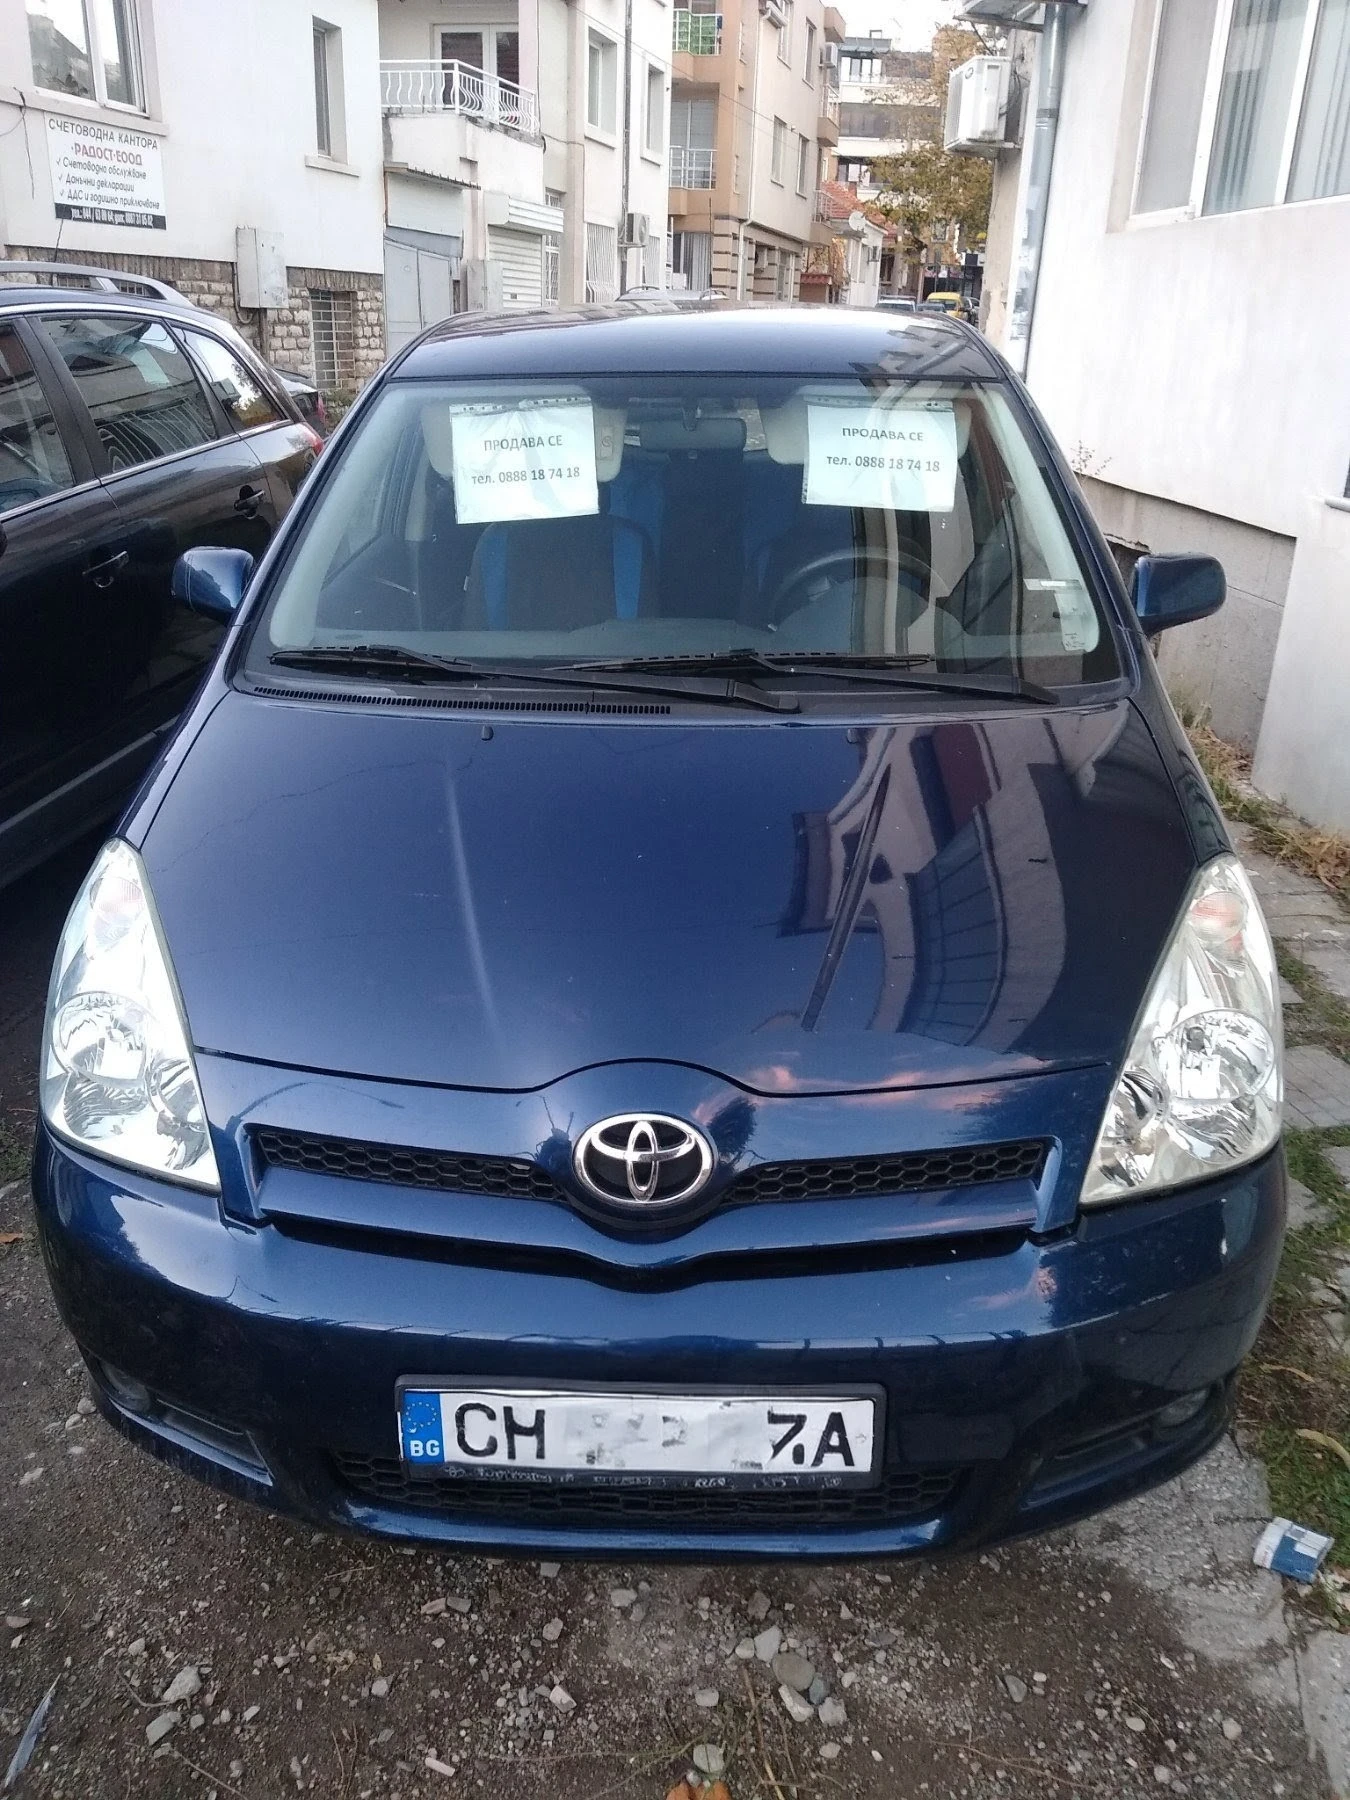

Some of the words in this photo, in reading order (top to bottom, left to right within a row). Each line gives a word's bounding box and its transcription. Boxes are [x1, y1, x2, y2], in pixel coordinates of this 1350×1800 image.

[48, 118, 115, 143] СЧЕТОВОДНА
[118, 133, 158, 150] КАНТОРА
[67, 189, 84, 201] ДДС
[842, 427, 906, 441] ПРОДАВА
[909, 431, 924, 441] СЕ
[484, 436, 545, 451] ПРОДАВА
[548, 435, 563, 447] СЕ
[826, 456, 851, 466] тел.
[855, 455, 885, 469] 0888
[888, 458, 904, 470] 18
[907, 459, 921, 471] 74
[925, 460, 940, 472] 18
[472, 475, 495, 485] тел.
[498, 470, 528, 484] 0888
[531, 469, 545, 481] 18
[548, 468, 563, 480] 74
[566, 466, 580, 478] 18
[409, 1439, 440, 1457] BG
